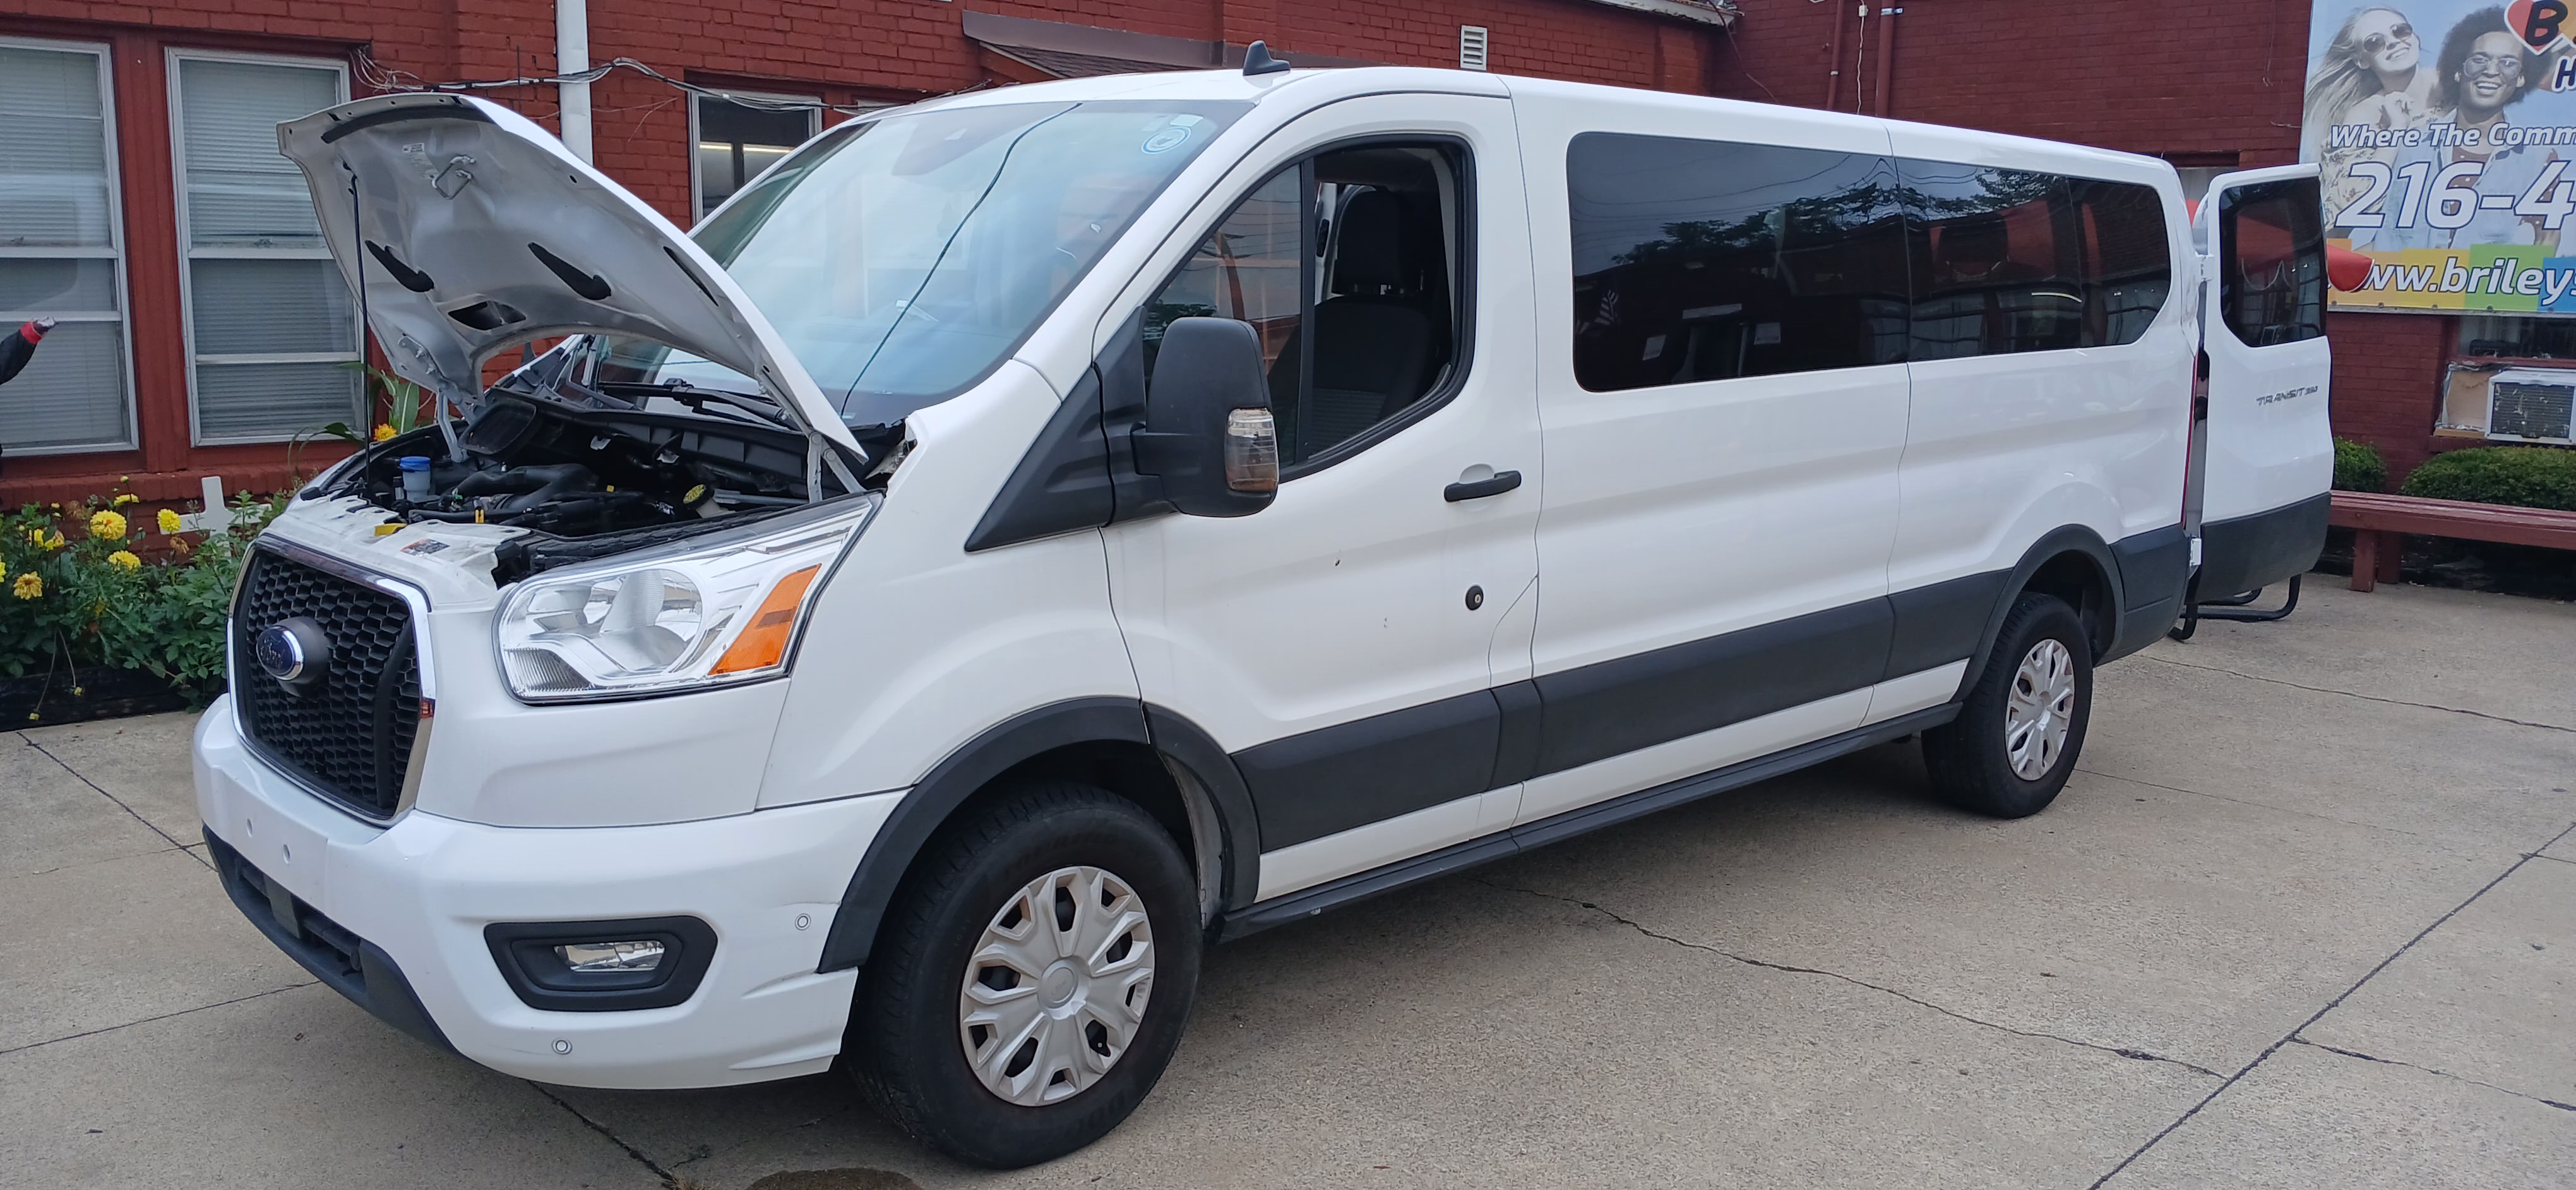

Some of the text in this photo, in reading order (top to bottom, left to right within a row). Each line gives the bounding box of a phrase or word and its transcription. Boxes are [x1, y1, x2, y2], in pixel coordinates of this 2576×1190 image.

[2331, 122, 2576, 148] Where The Comm
[2334, 160, 2576, 231] 216-4
[2256, 387, 2305, 406] TRANSIT
